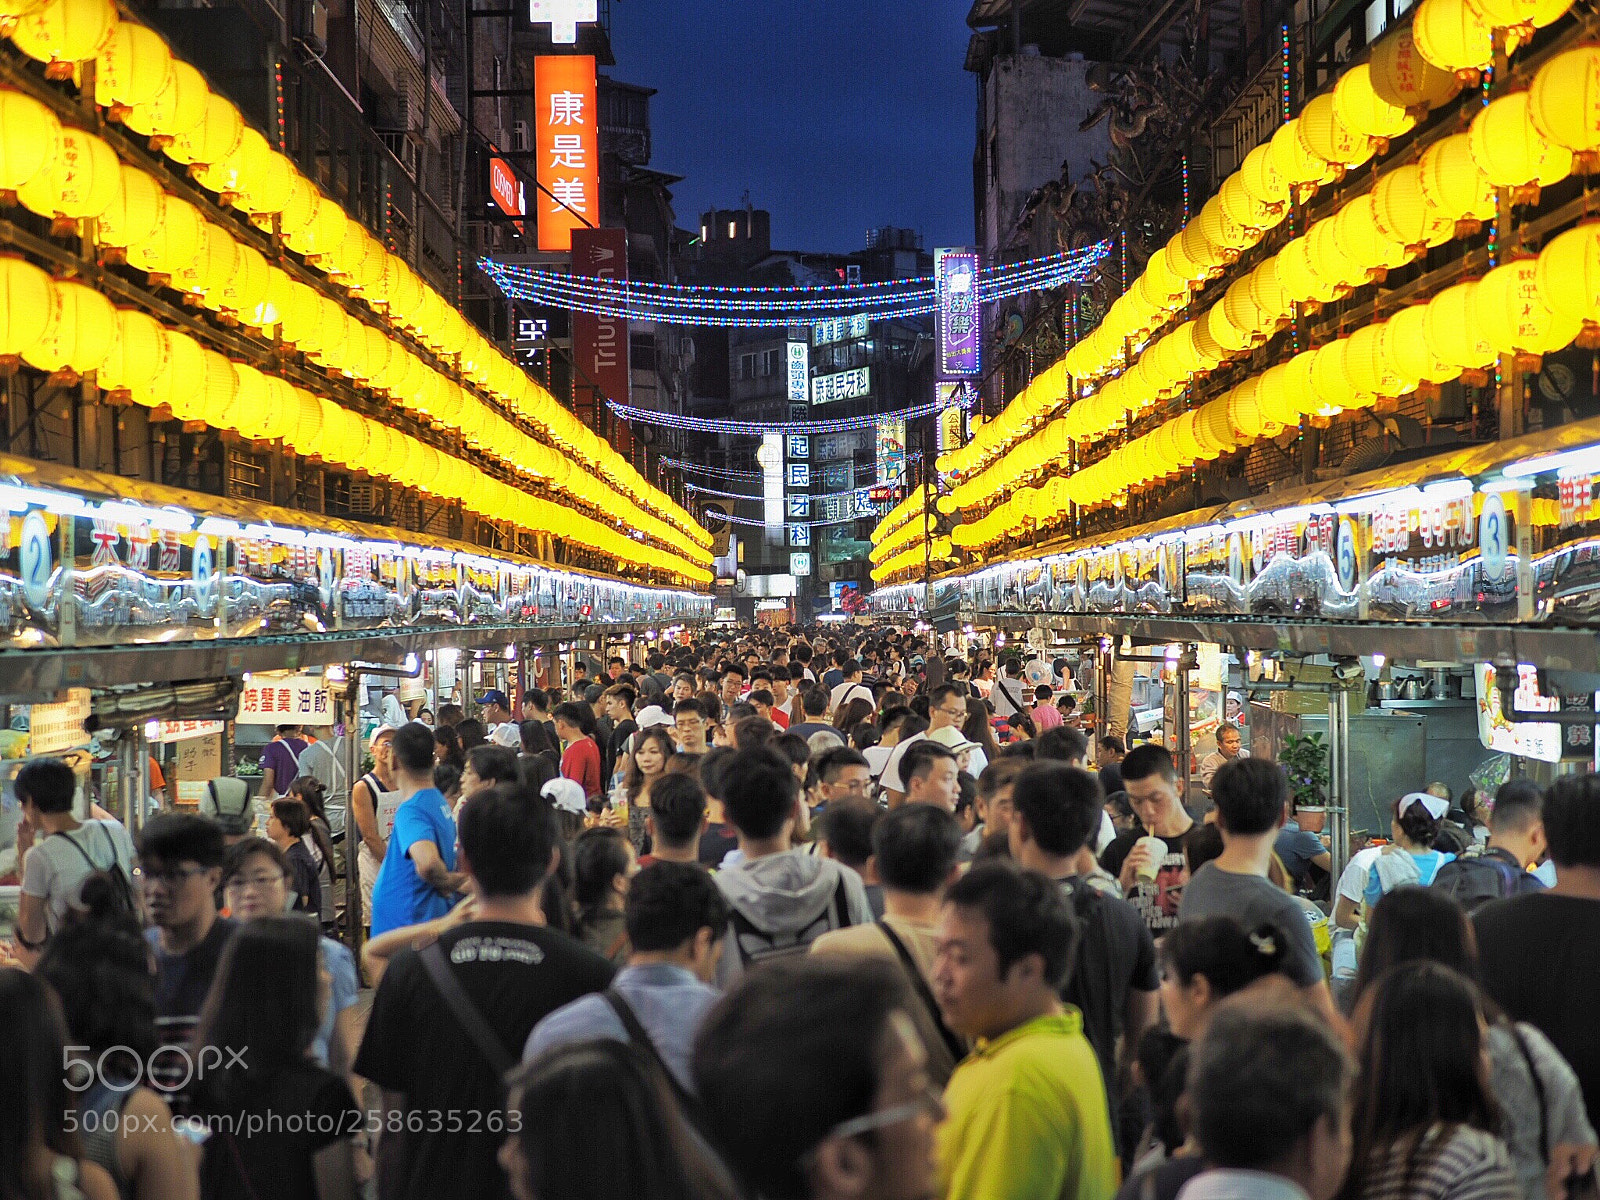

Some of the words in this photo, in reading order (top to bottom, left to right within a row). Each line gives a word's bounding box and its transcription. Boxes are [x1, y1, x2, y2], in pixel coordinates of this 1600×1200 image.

[549, 91, 586, 213] 康是美
[30, 535, 42, 587] 2
[1341, 535, 1351, 580] 5
[1488, 512, 1500, 565] 3
[298, 688, 327, 713] 油飯
